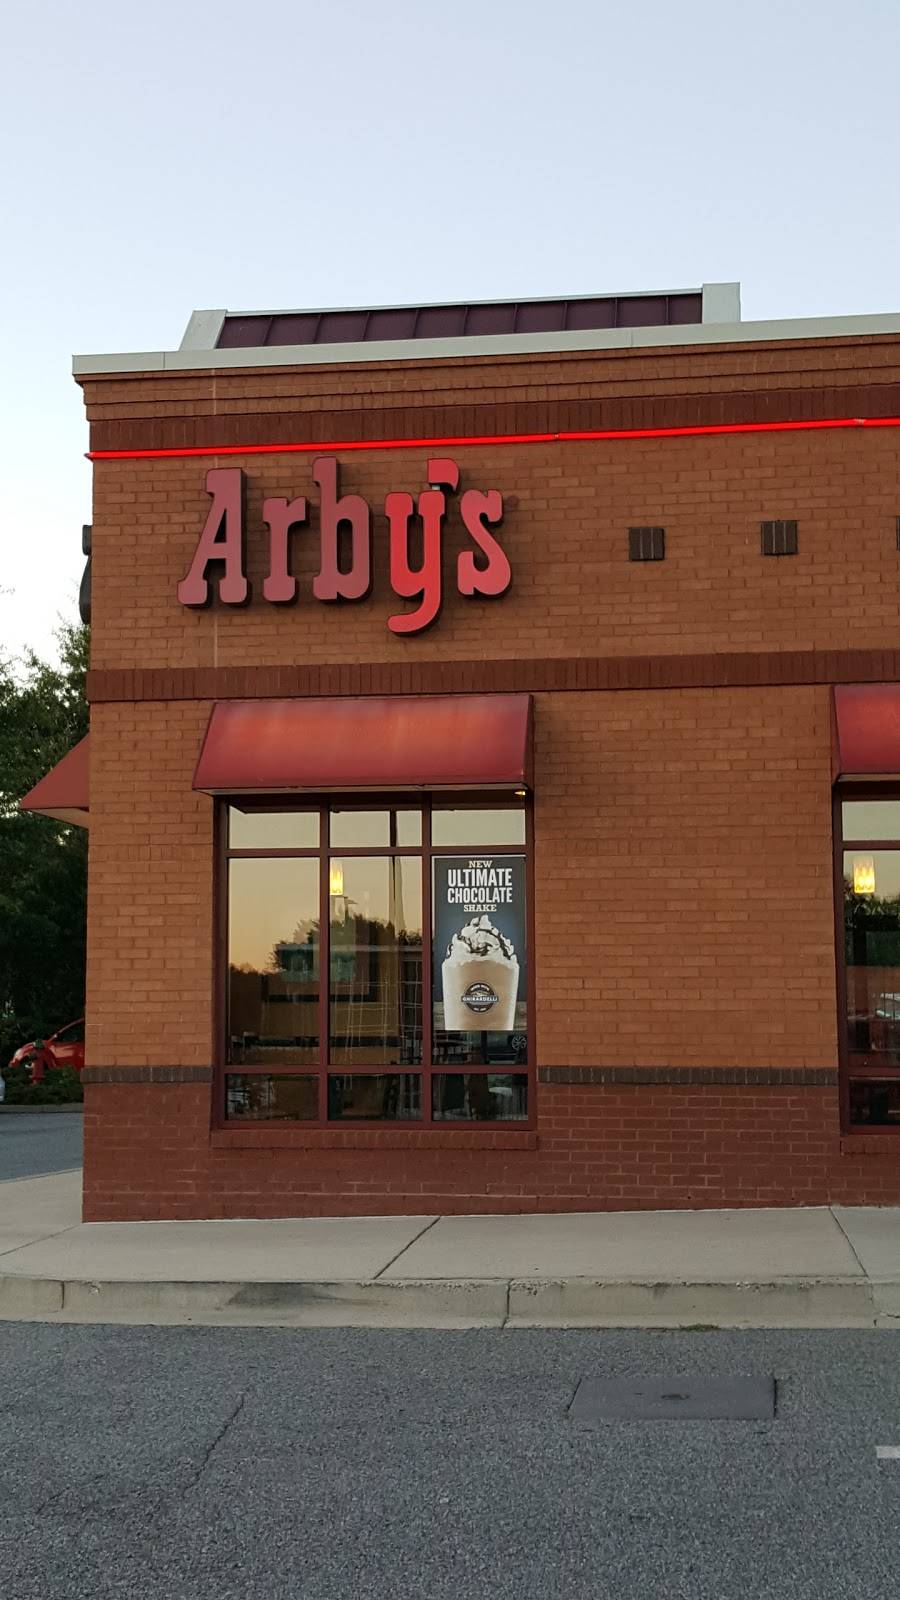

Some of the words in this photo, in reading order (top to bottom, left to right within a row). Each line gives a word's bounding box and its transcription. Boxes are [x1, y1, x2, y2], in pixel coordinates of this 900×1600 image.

[177, 455, 512, 634] Arby's
[468, 860, 493, 868] NEW
[447, 868, 513, 887] ULTIMATE
[447, 887, 513, 904] CHOCOLATE
[463, 904, 497, 912] SHAKE
